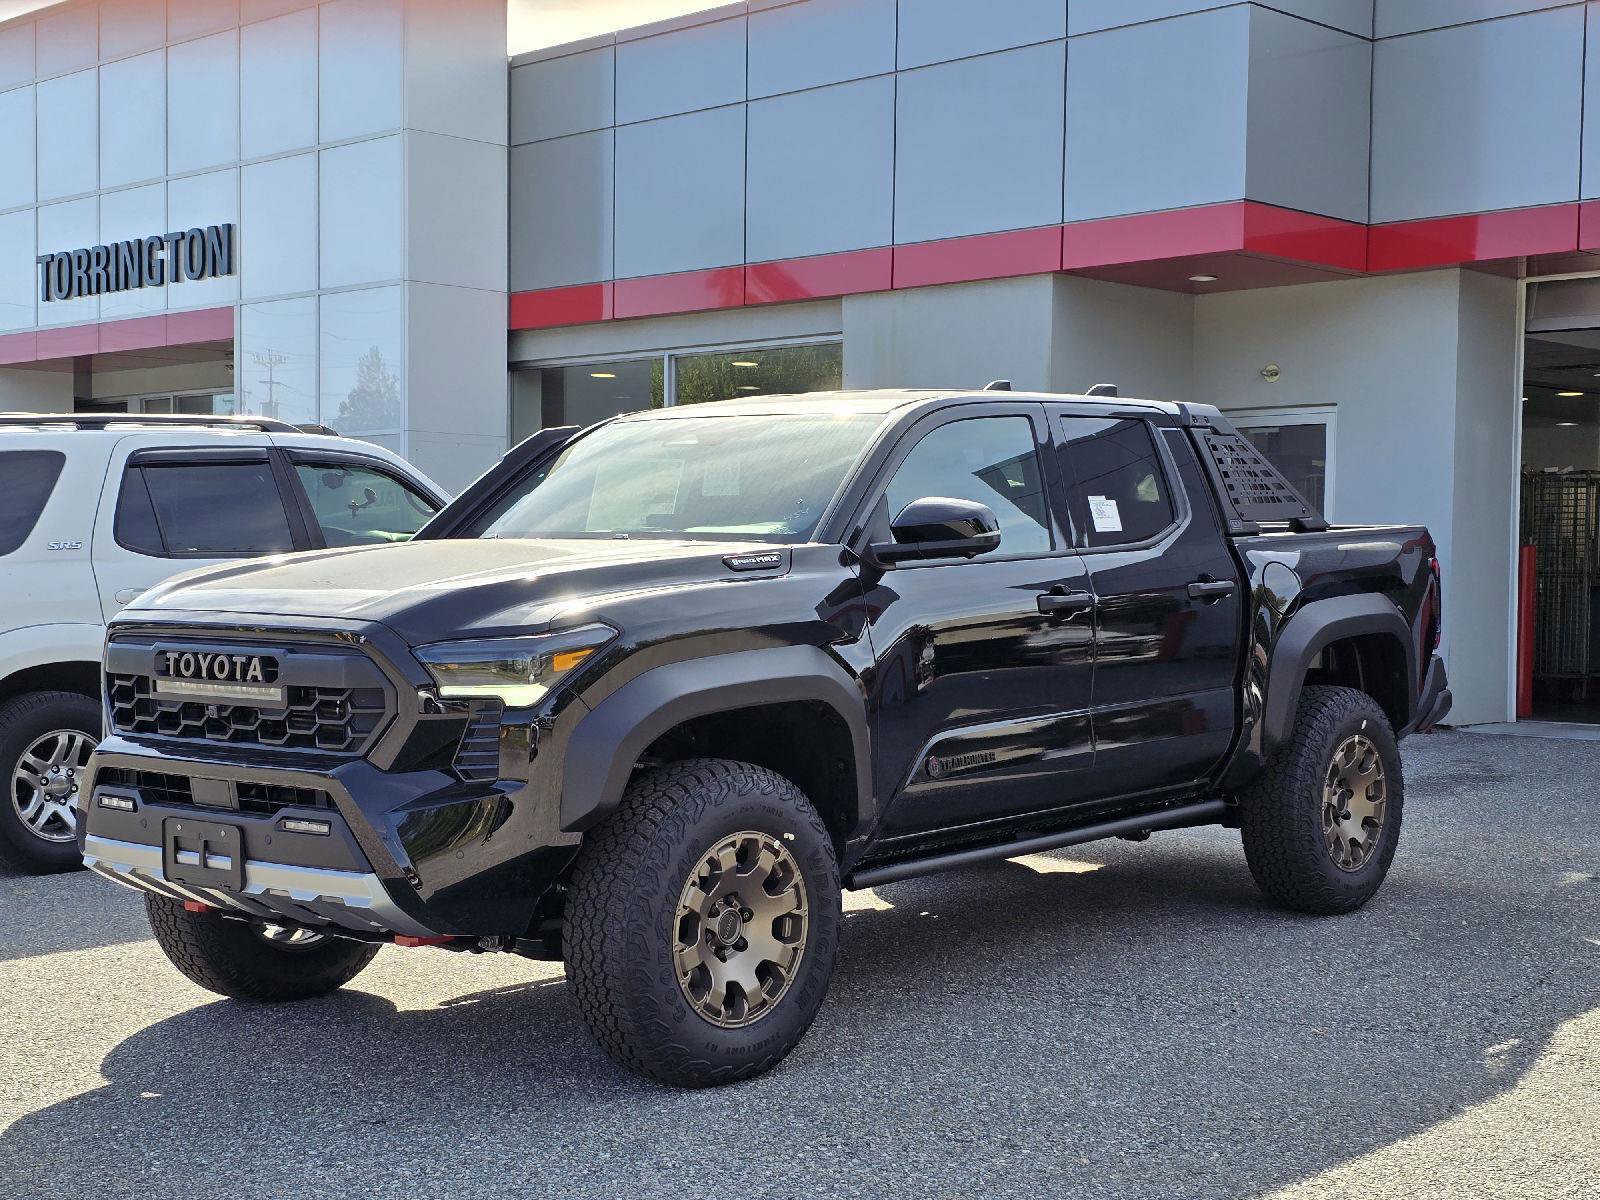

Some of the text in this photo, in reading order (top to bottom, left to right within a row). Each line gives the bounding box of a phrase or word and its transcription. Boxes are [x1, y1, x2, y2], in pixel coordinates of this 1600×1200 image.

[36, 223, 235, 301] TORRINGTON
[756, 554, 779, 564] MAX
[166, 652, 263, 681] TOYOTA
